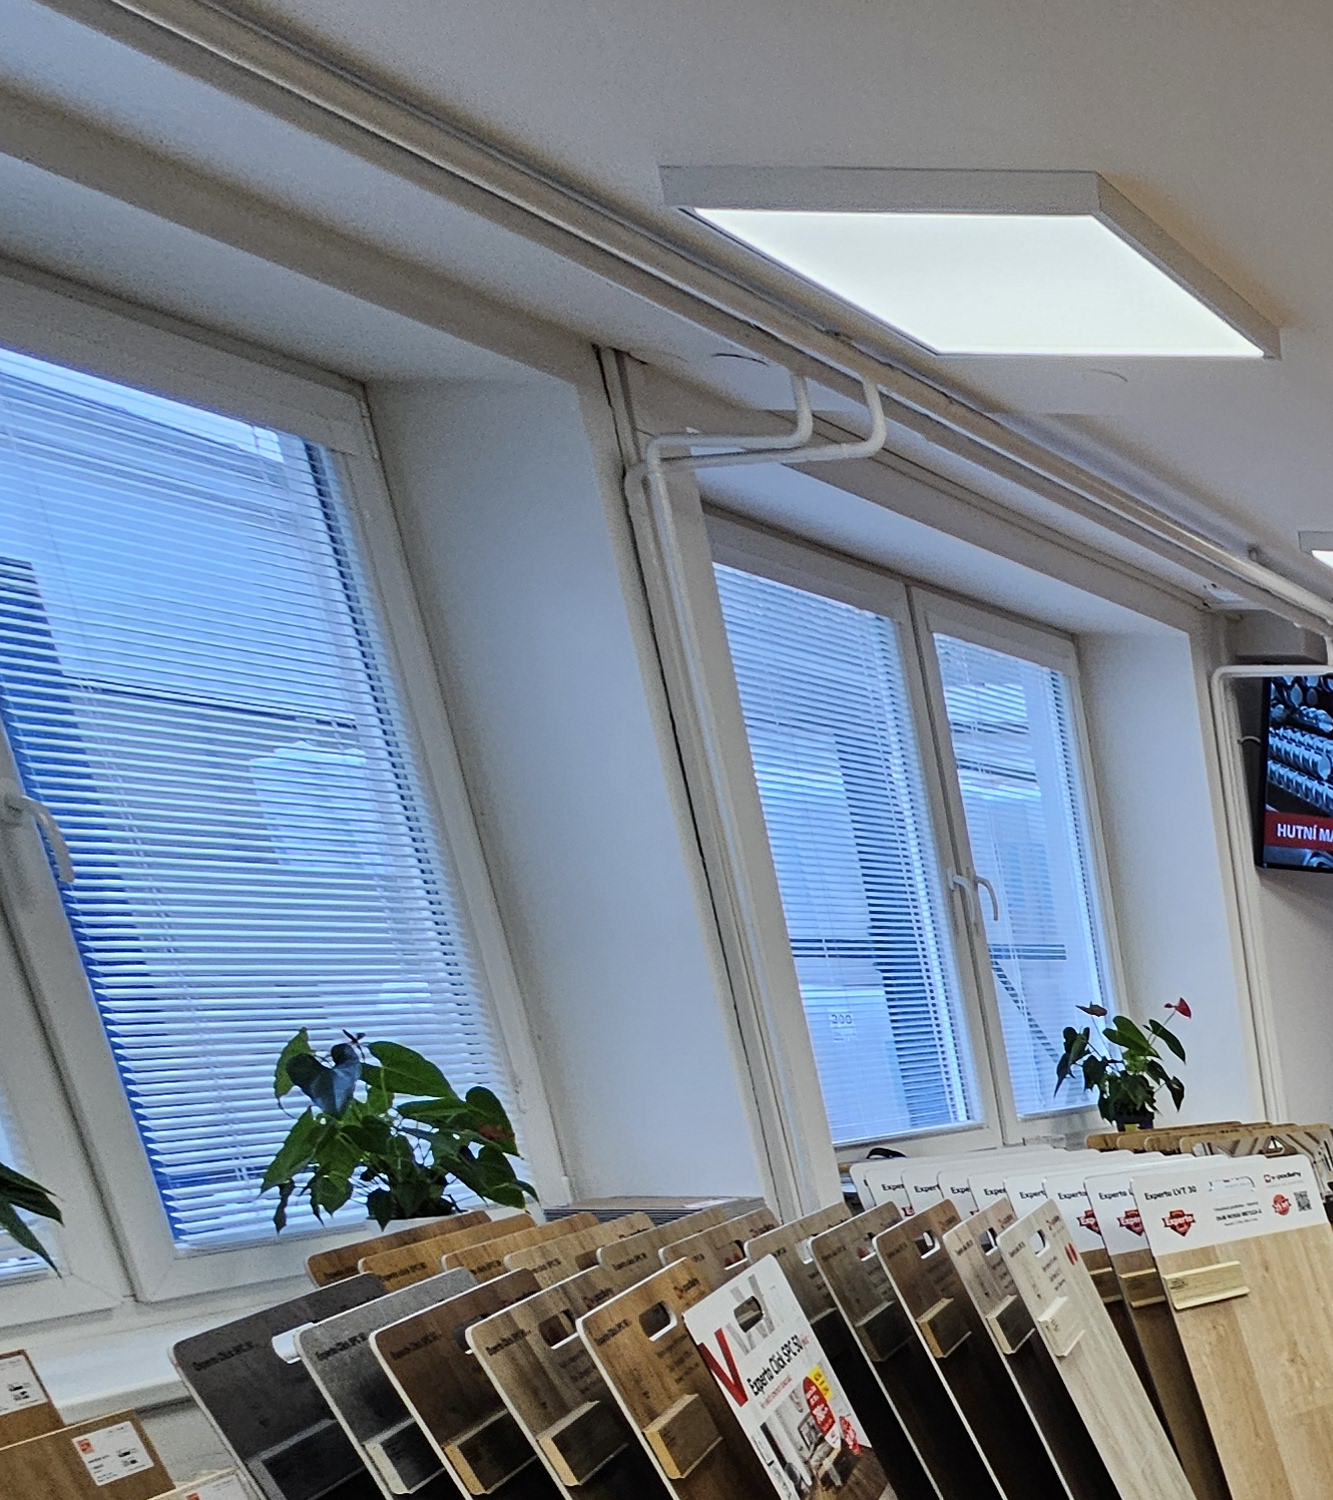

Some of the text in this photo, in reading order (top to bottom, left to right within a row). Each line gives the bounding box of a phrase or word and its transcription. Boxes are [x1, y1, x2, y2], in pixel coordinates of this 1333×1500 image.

[1277, 823, 1317, 841] HUTNÍ
[1144, 1190, 1173, 1201] Experto
[1173, 1187, 1186, 1198] LVT
